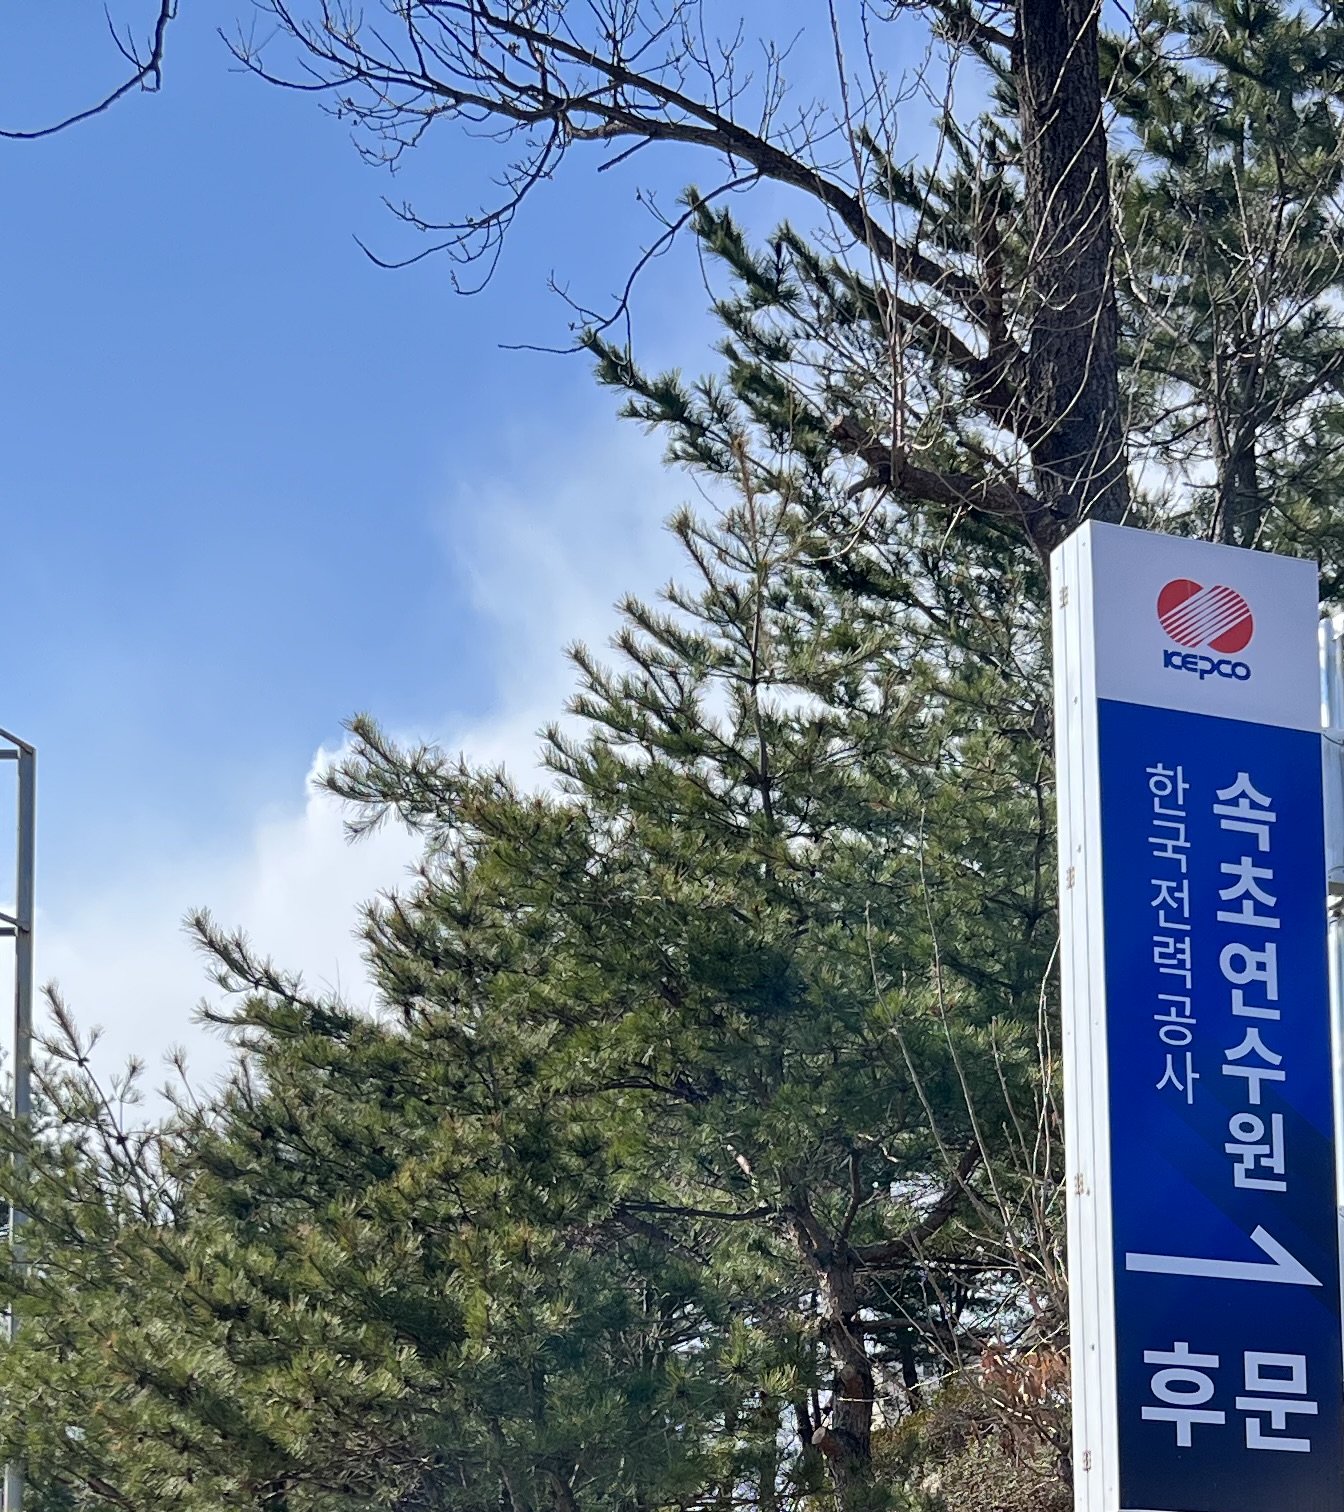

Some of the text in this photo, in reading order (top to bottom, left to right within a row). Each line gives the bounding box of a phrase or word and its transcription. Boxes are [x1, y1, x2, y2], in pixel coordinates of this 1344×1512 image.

[1163, 649, 1252, 680] KEPCO
[1145, 762, 1200, 1105] 한국전력공사
[1212, 771, 1288, 1193] 속초연수원
[1140, 1341, 1319, 1453] 후문
